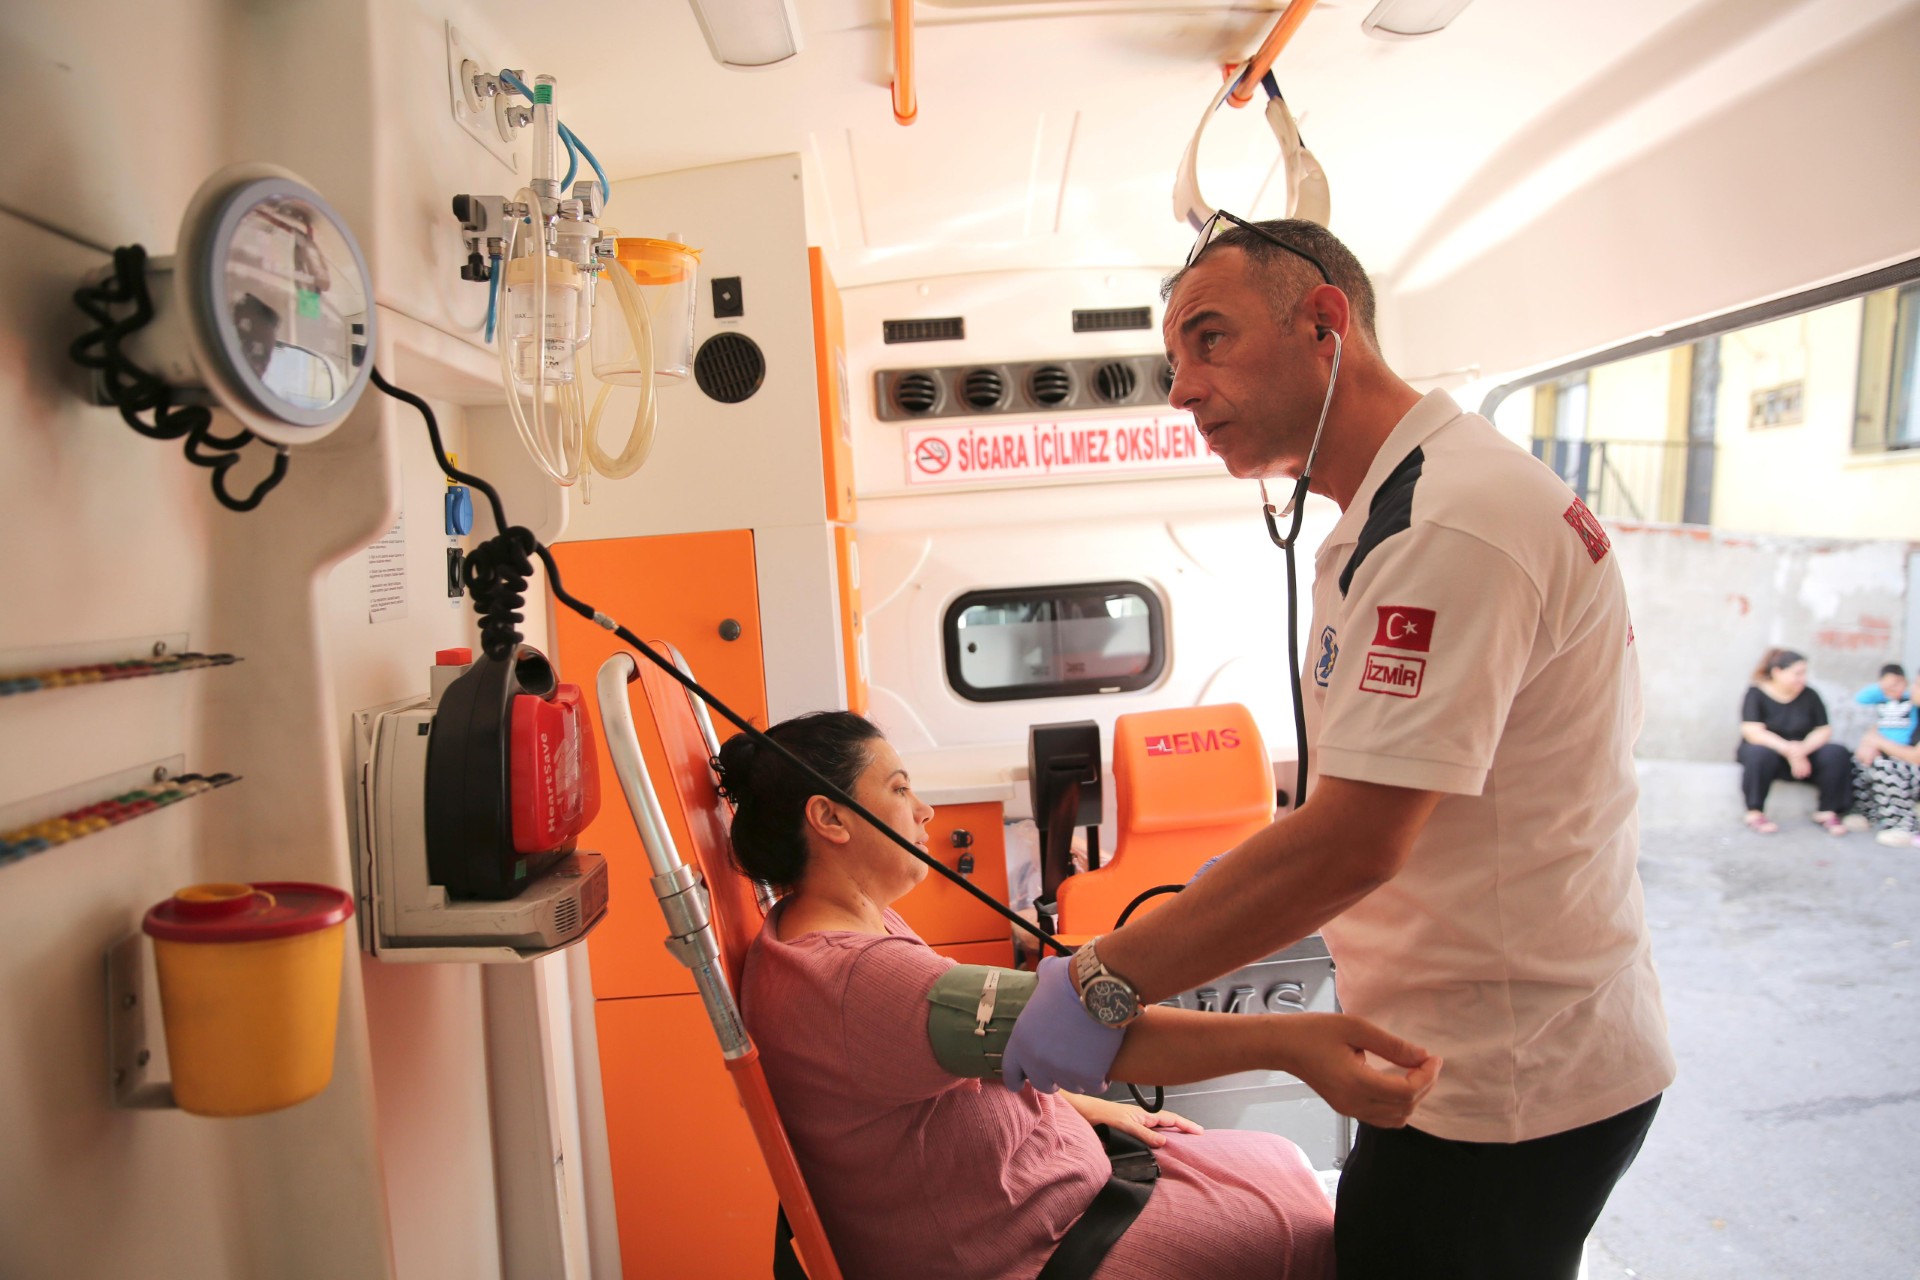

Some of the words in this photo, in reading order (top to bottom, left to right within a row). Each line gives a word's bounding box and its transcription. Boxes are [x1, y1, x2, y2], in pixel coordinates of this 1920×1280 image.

[957, 429, 1029, 471] SİGARA
[1033, 424, 1110, 473] İÇİLMEZ
[1116, 418, 1197, 463] OKSİJEN
[1367, 659, 1418, 687] İZMİR
[1172, 728, 1241, 755] EMS
[540, 732, 556, 833] HeartSave
[1157, 982, 1306, 1014] MS
